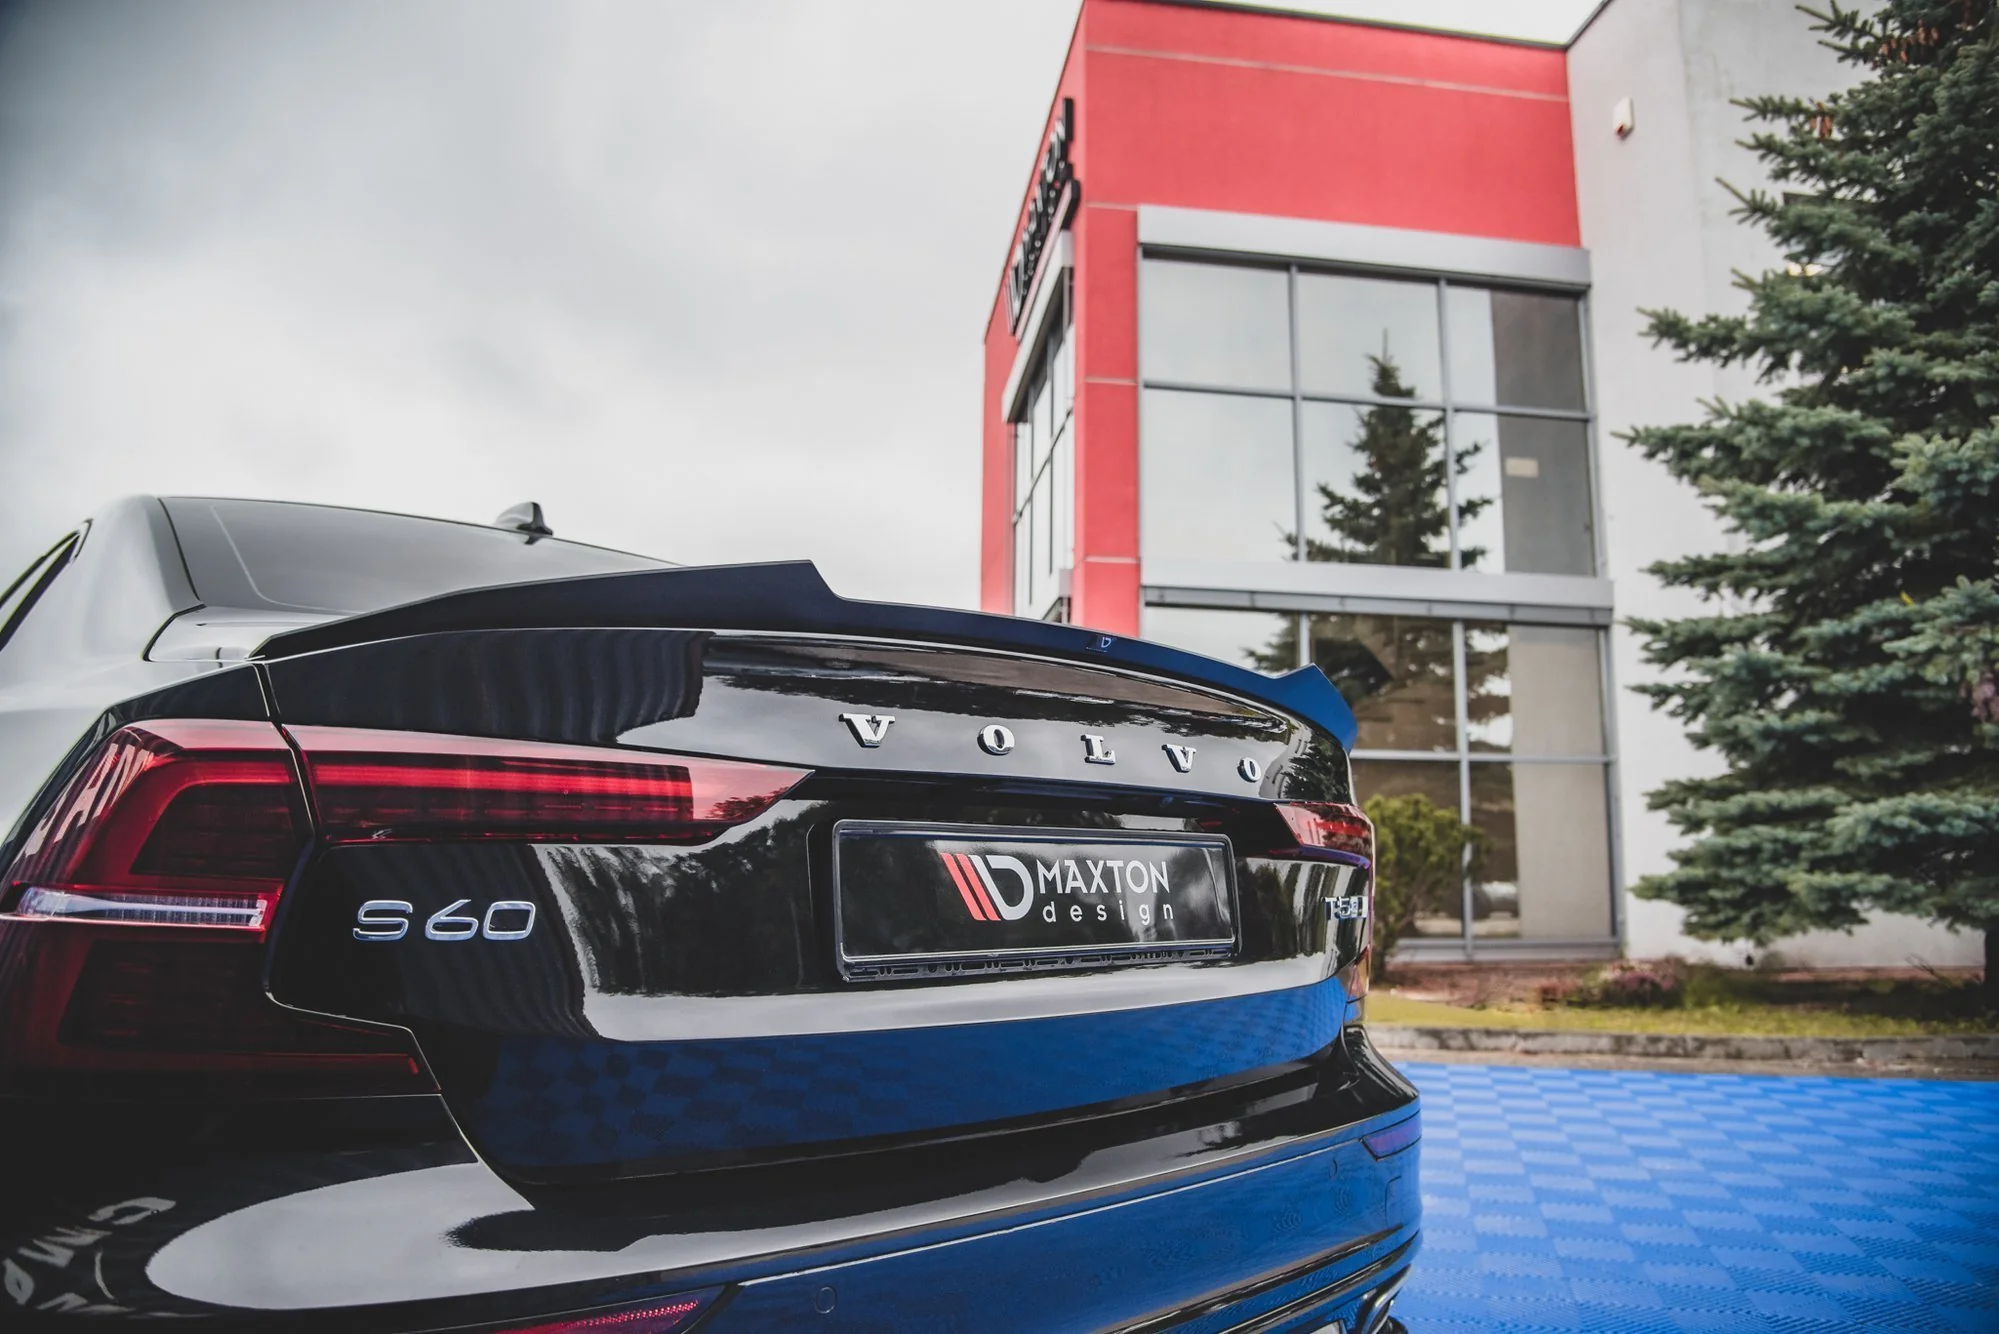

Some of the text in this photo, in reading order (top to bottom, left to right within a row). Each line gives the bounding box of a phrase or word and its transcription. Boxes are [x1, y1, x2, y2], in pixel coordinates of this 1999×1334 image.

[838, 713, 1263, 783] VOLVO
[1036, 859, 1170, 894] MAXTON
[1042, 900, 1174, 926] design
